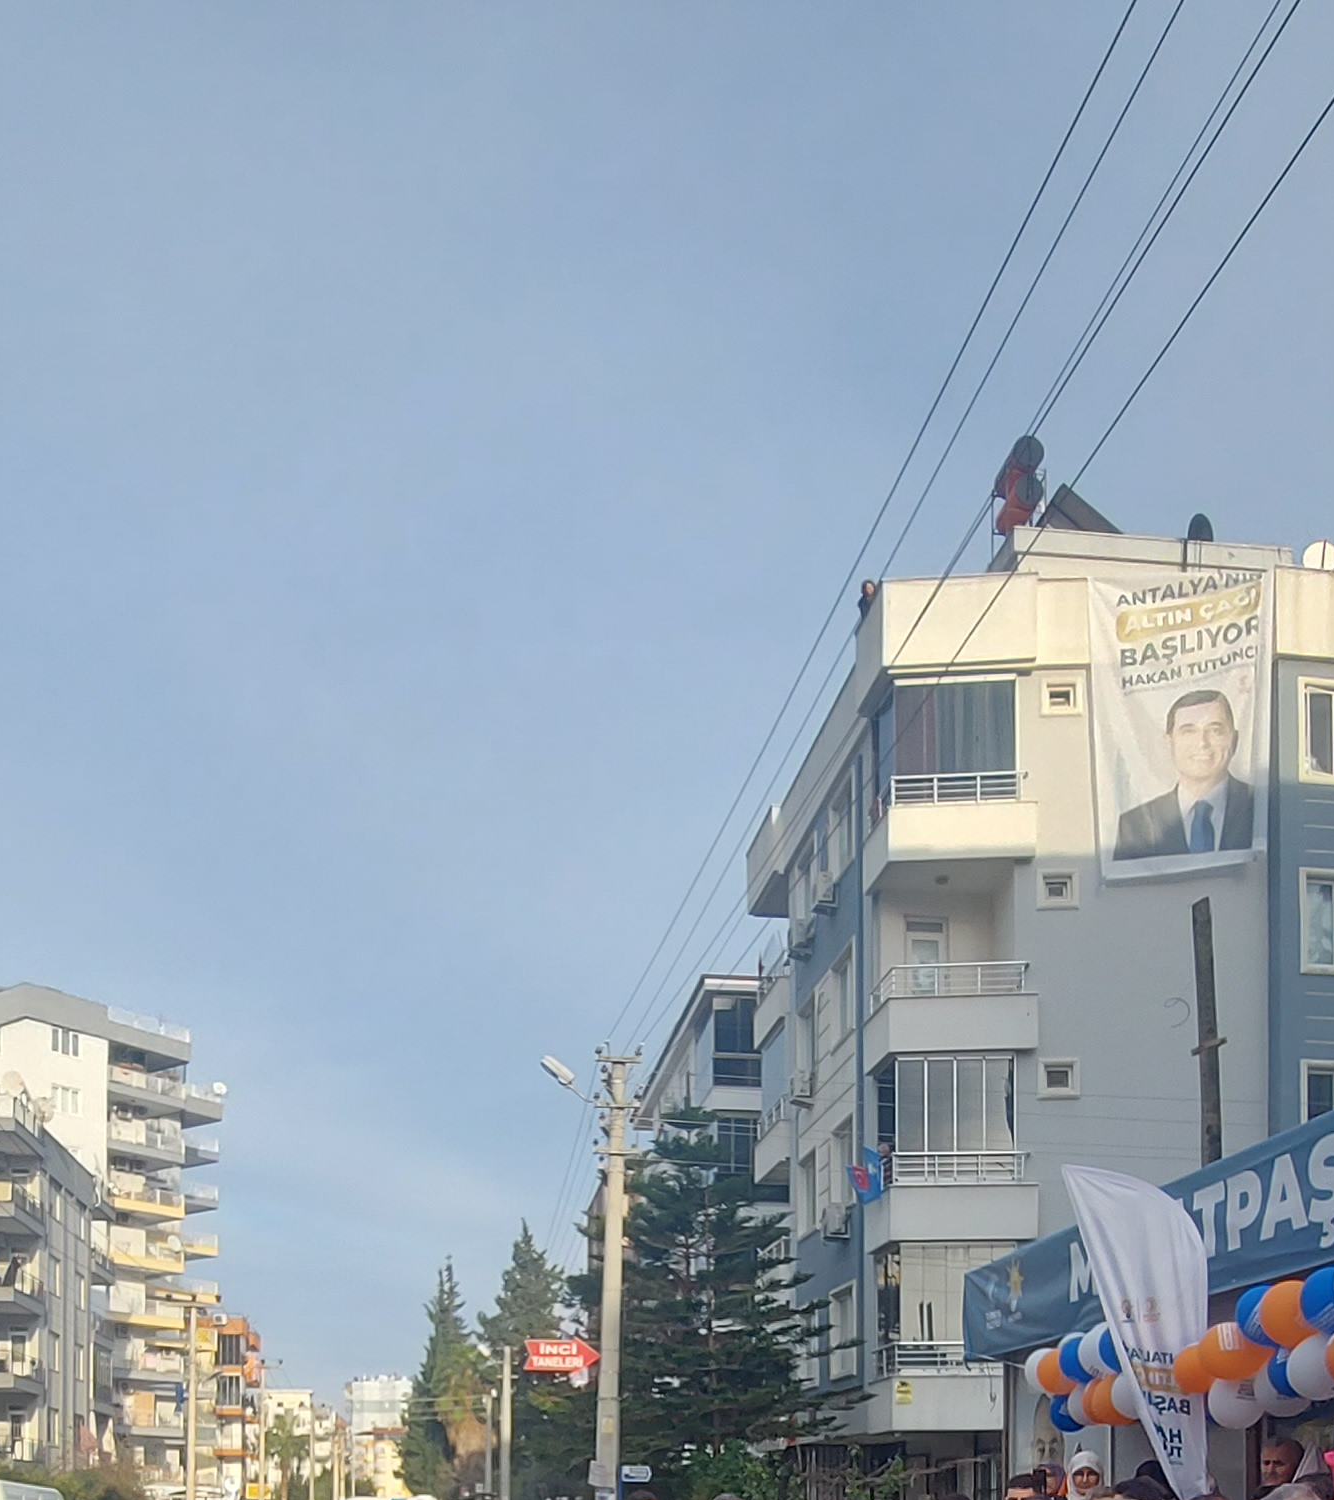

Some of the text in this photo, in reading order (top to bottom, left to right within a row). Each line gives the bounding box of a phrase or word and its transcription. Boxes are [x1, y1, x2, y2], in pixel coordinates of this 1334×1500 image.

[1124, 608, 1192, 634] ALTIN
[1120, 614, 1259, 667] BAŞLIYOR
[1121, 665, 1182, 690] HAKAN
